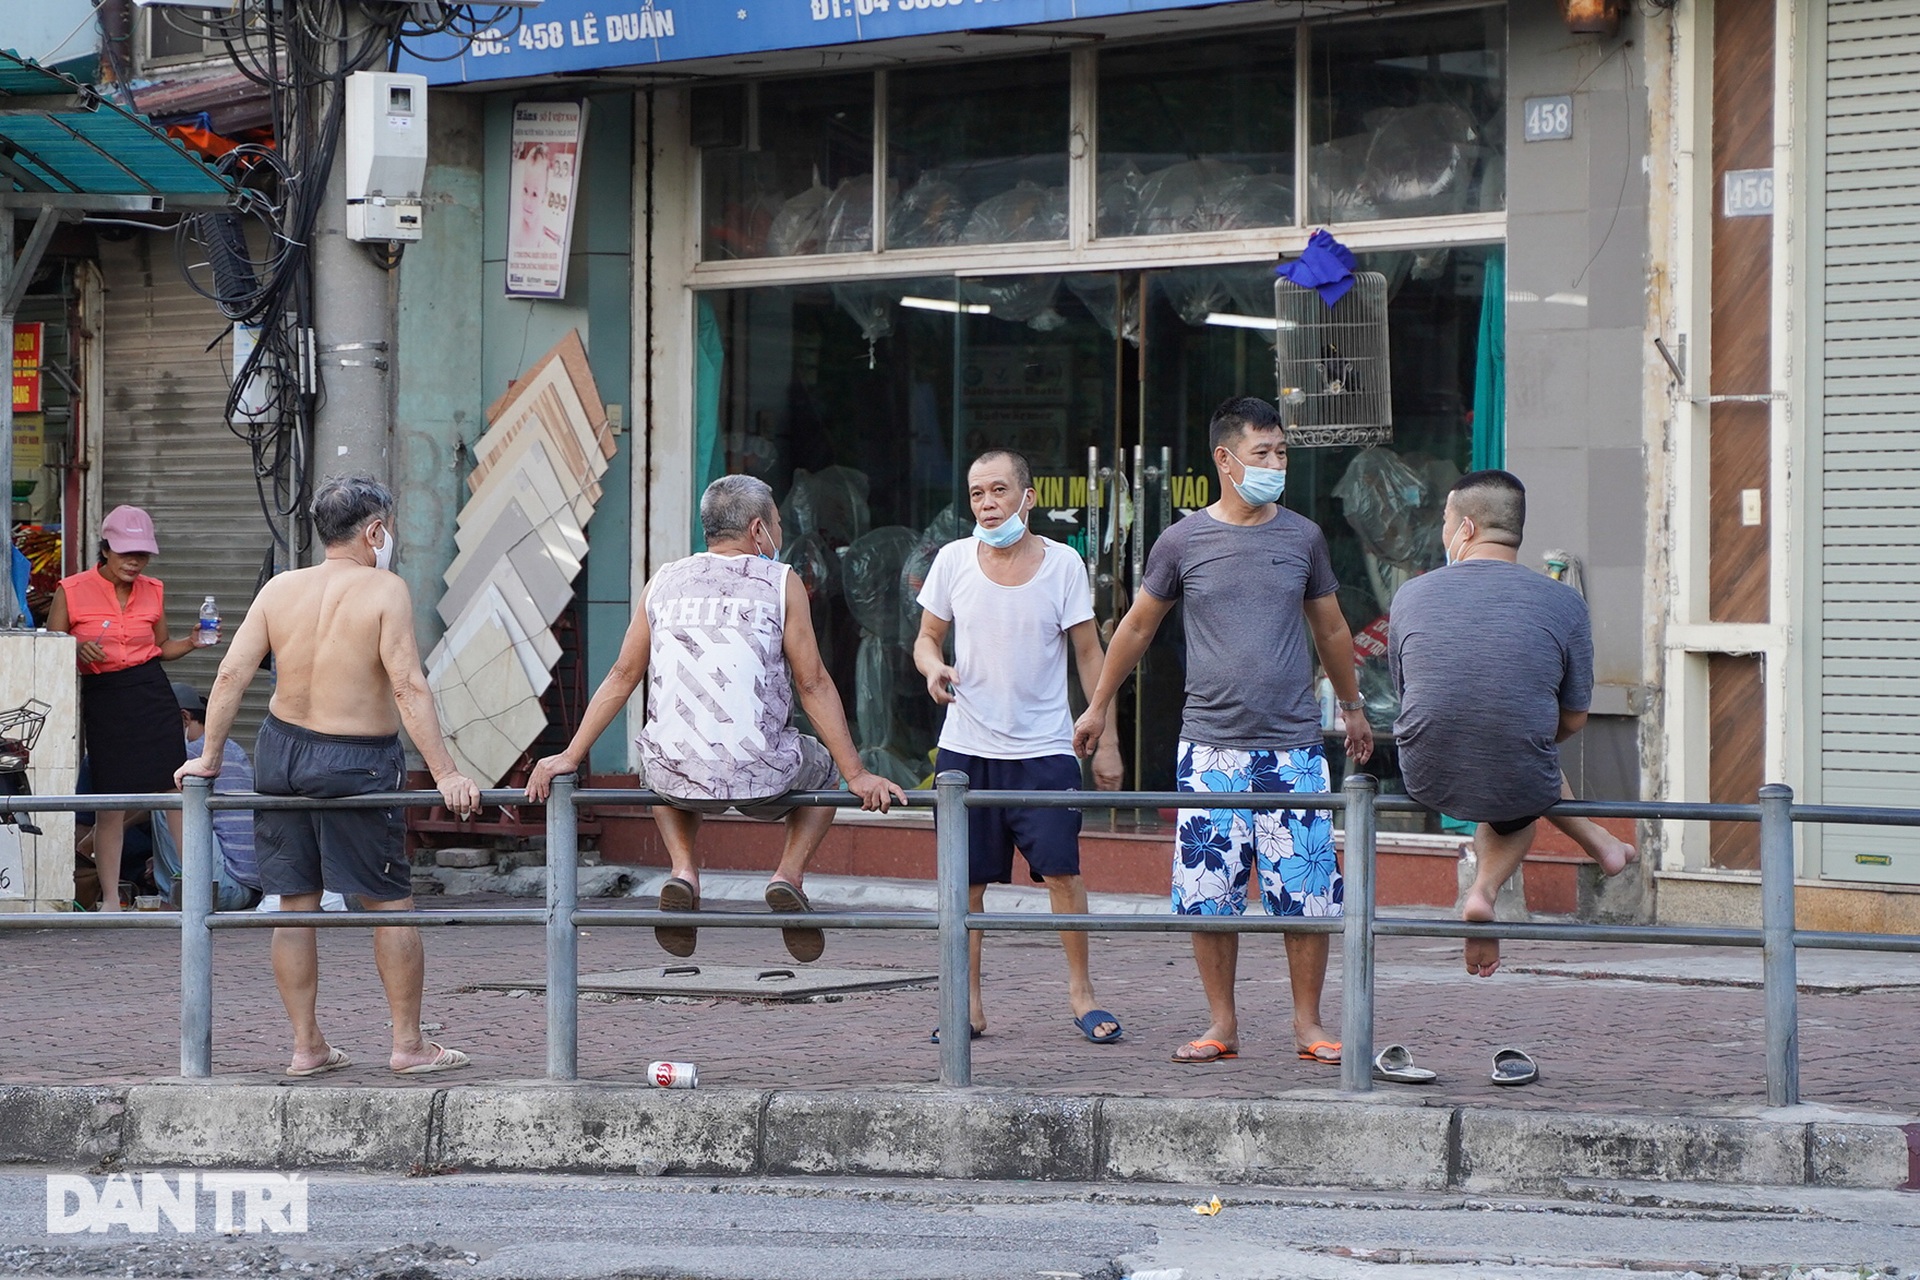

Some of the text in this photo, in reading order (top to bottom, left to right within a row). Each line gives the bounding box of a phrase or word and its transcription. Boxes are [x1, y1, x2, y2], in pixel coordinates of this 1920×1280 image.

[518, 21, 564, 50] 458
[570, 12, 600, 46] LÊ
[605, 1, 675, 43] DUẨN
[1528, 103, 1569, 134] 458
[1729, 177, 1773, 209] 456
[1033, 477, 1064, 508] XIN
[652, 597, 777, 633] WHITE
